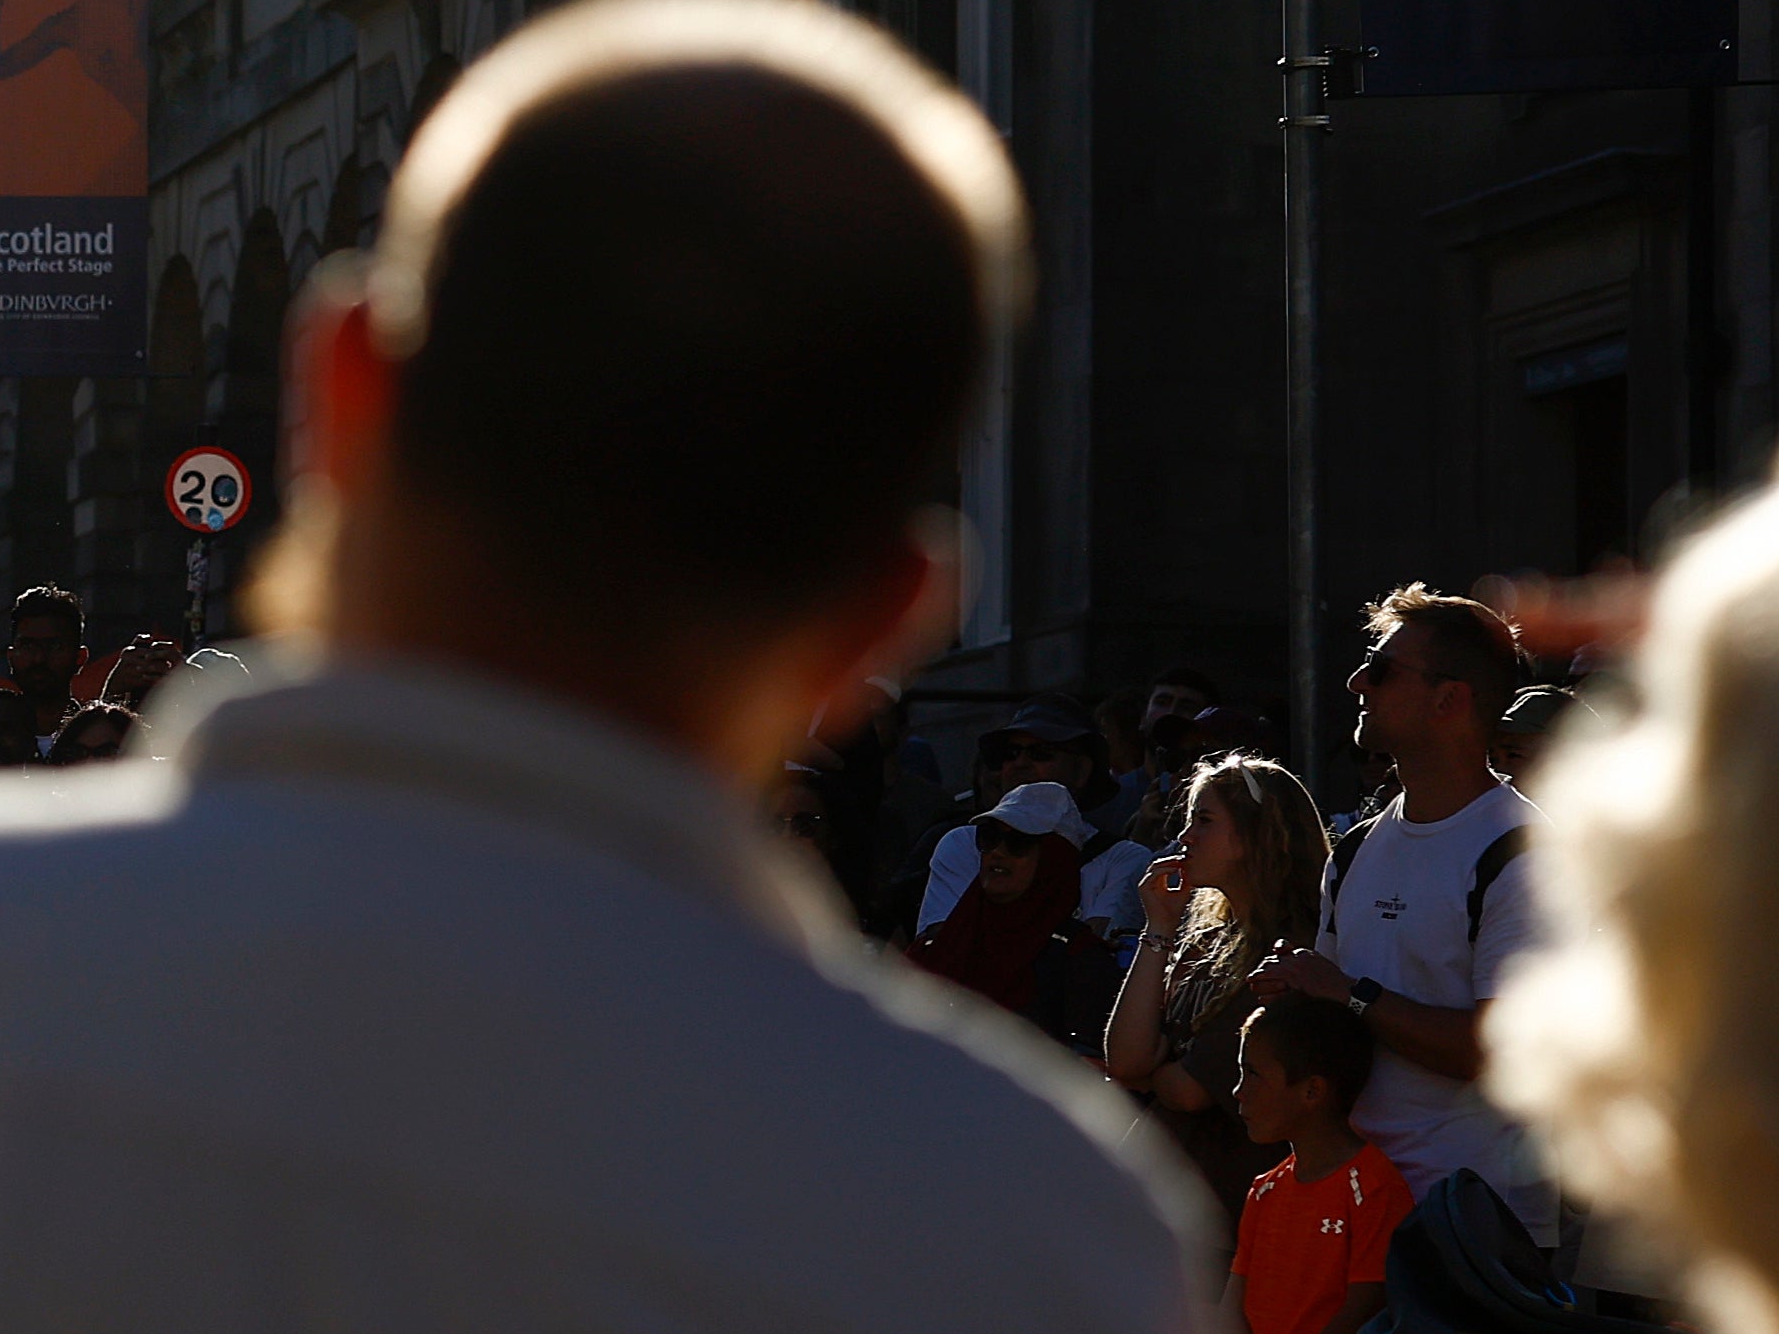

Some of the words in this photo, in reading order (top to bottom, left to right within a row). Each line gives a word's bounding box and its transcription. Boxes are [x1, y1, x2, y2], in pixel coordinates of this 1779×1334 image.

[6, 257, 64, 273] Perfect
[68, 258, 113, 277] Stage
[180, 470, 238, 507] 20
